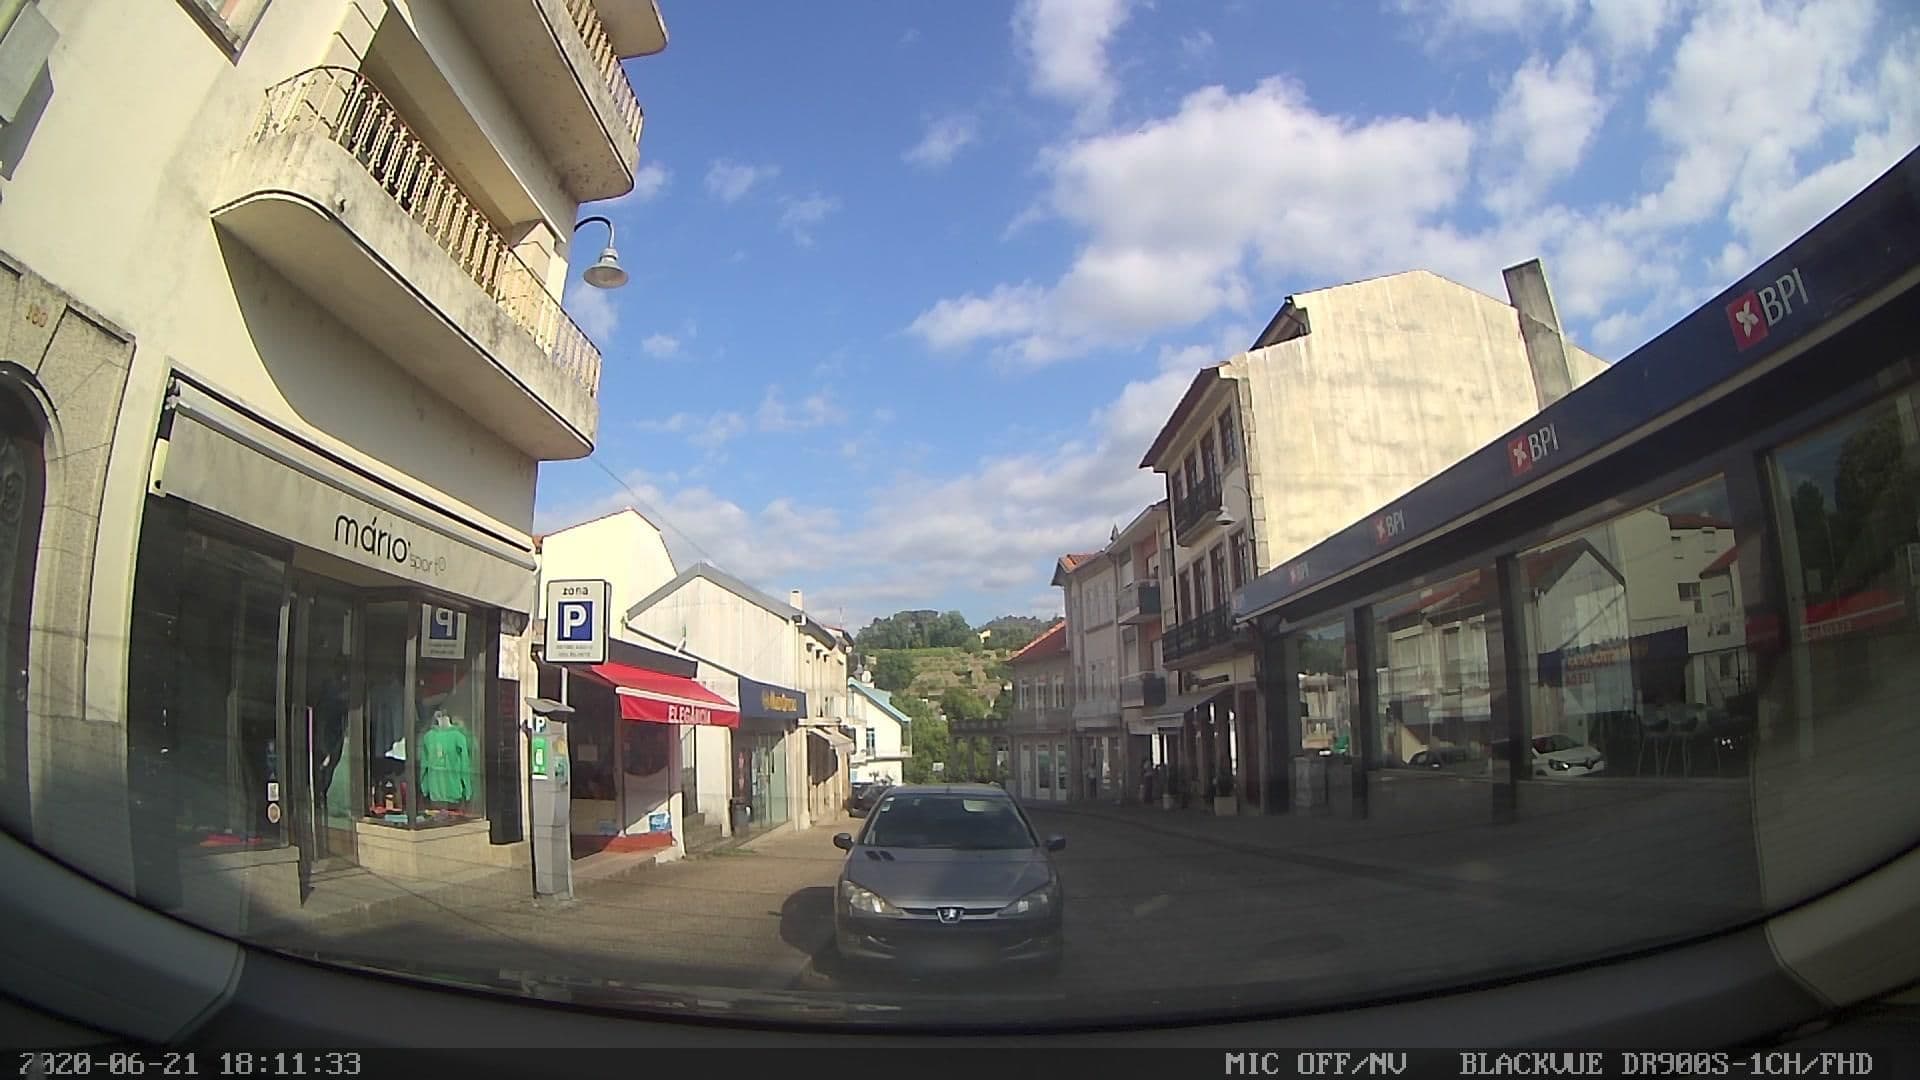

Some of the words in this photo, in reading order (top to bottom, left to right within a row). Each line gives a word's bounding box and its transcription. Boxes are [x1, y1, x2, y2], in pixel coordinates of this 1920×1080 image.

[1758, 267, 1809, 326] BPI
[1528, 423, 1559, 462] BPI
[334, 514, 409, 564] mário
[1386, 509, 1405, 536] BPI
[562, 586, 589, 596] zona
[563, 604, 588, 638] P
